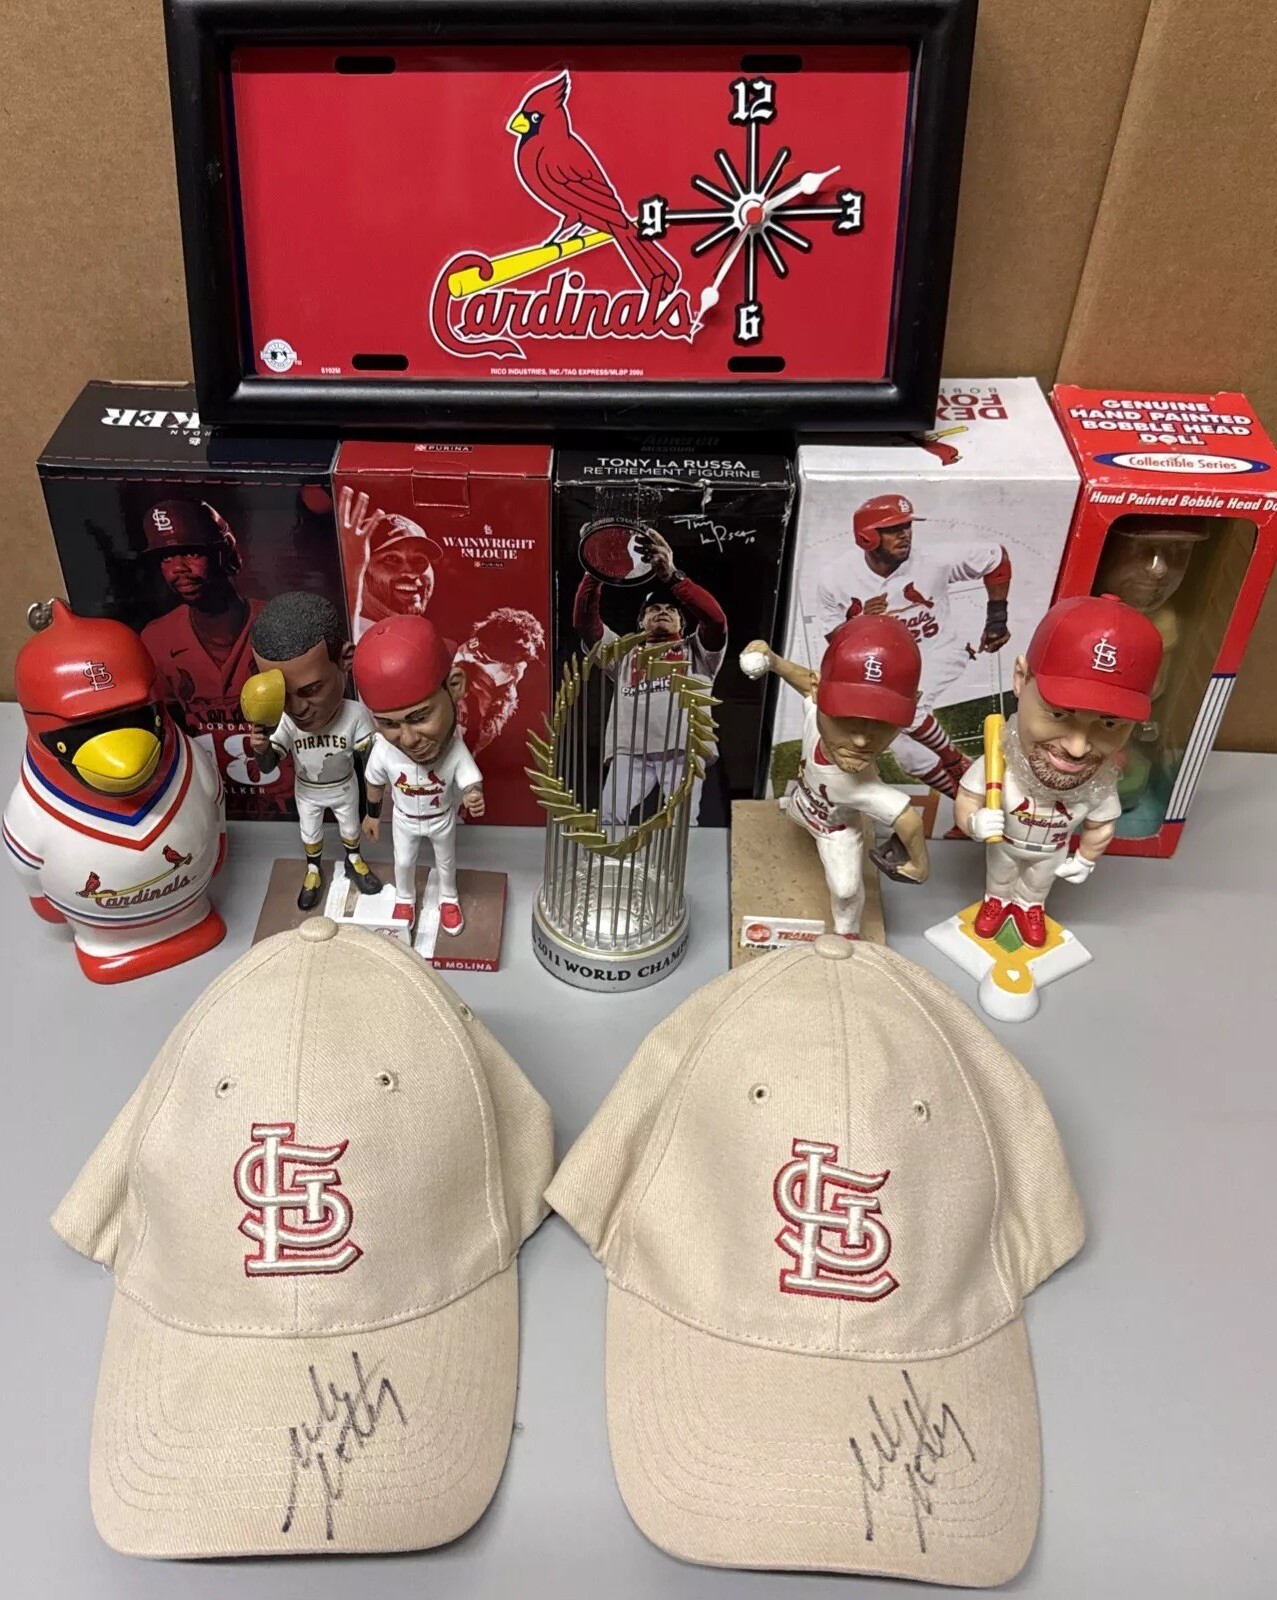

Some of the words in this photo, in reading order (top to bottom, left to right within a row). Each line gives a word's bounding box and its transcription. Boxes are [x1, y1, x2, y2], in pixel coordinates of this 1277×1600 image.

[731, 78, 775, 123] 12
[640, 197, 666, 238] 9
[835, 191, 863, 231] 3
[429, 250, 704, 359] Cardinals
[735, 302, 762, 343] 6
[1102, 399, 1211, 413] GENUINE
[100, 407, 201, 429] KER
[1070, 408, 1142, 420] HAND
[1149, 412, 1252, 425] PAINTED
[1082, 420, 1176, 432] BOBBLE
[1184, 425, 1252, 436] HEAD
[1140, 433, 1206, 445] DOLL
[597, 457, 650, 468] TONY
[656, 460, 678, 468] LA
[683, 459, 746, 470] RUSSA
[1129, 456, 1194, 468] Collectible
[1198, 459, 1237, 470] Series
[583, 466, 684, 476] RETIREMENT
[688, 468, 761, 479] FIGURINE
[1090, 491, 1126, 505] Hand
[1126, 493, 1177, 506] Painted
[1180, 495, 1224, 509] Bobble
[1227, 499, 1263, 511] Head
[443, 537, 535, 549] WAINWRIGHT
[476, 548, 518, 559] LOUIE
[198, 723, 255, 731] JORDAN
[295, 735, 347, 753] PIRATES
[1018, 811, 1068, 828] Cardinals
[95, 875, 197, 909] Cardinals
[446, 961, 493, 971] MOLINA
[538, 937, 561, 966] 2011
[563, 958, 632, 981] WORLD
